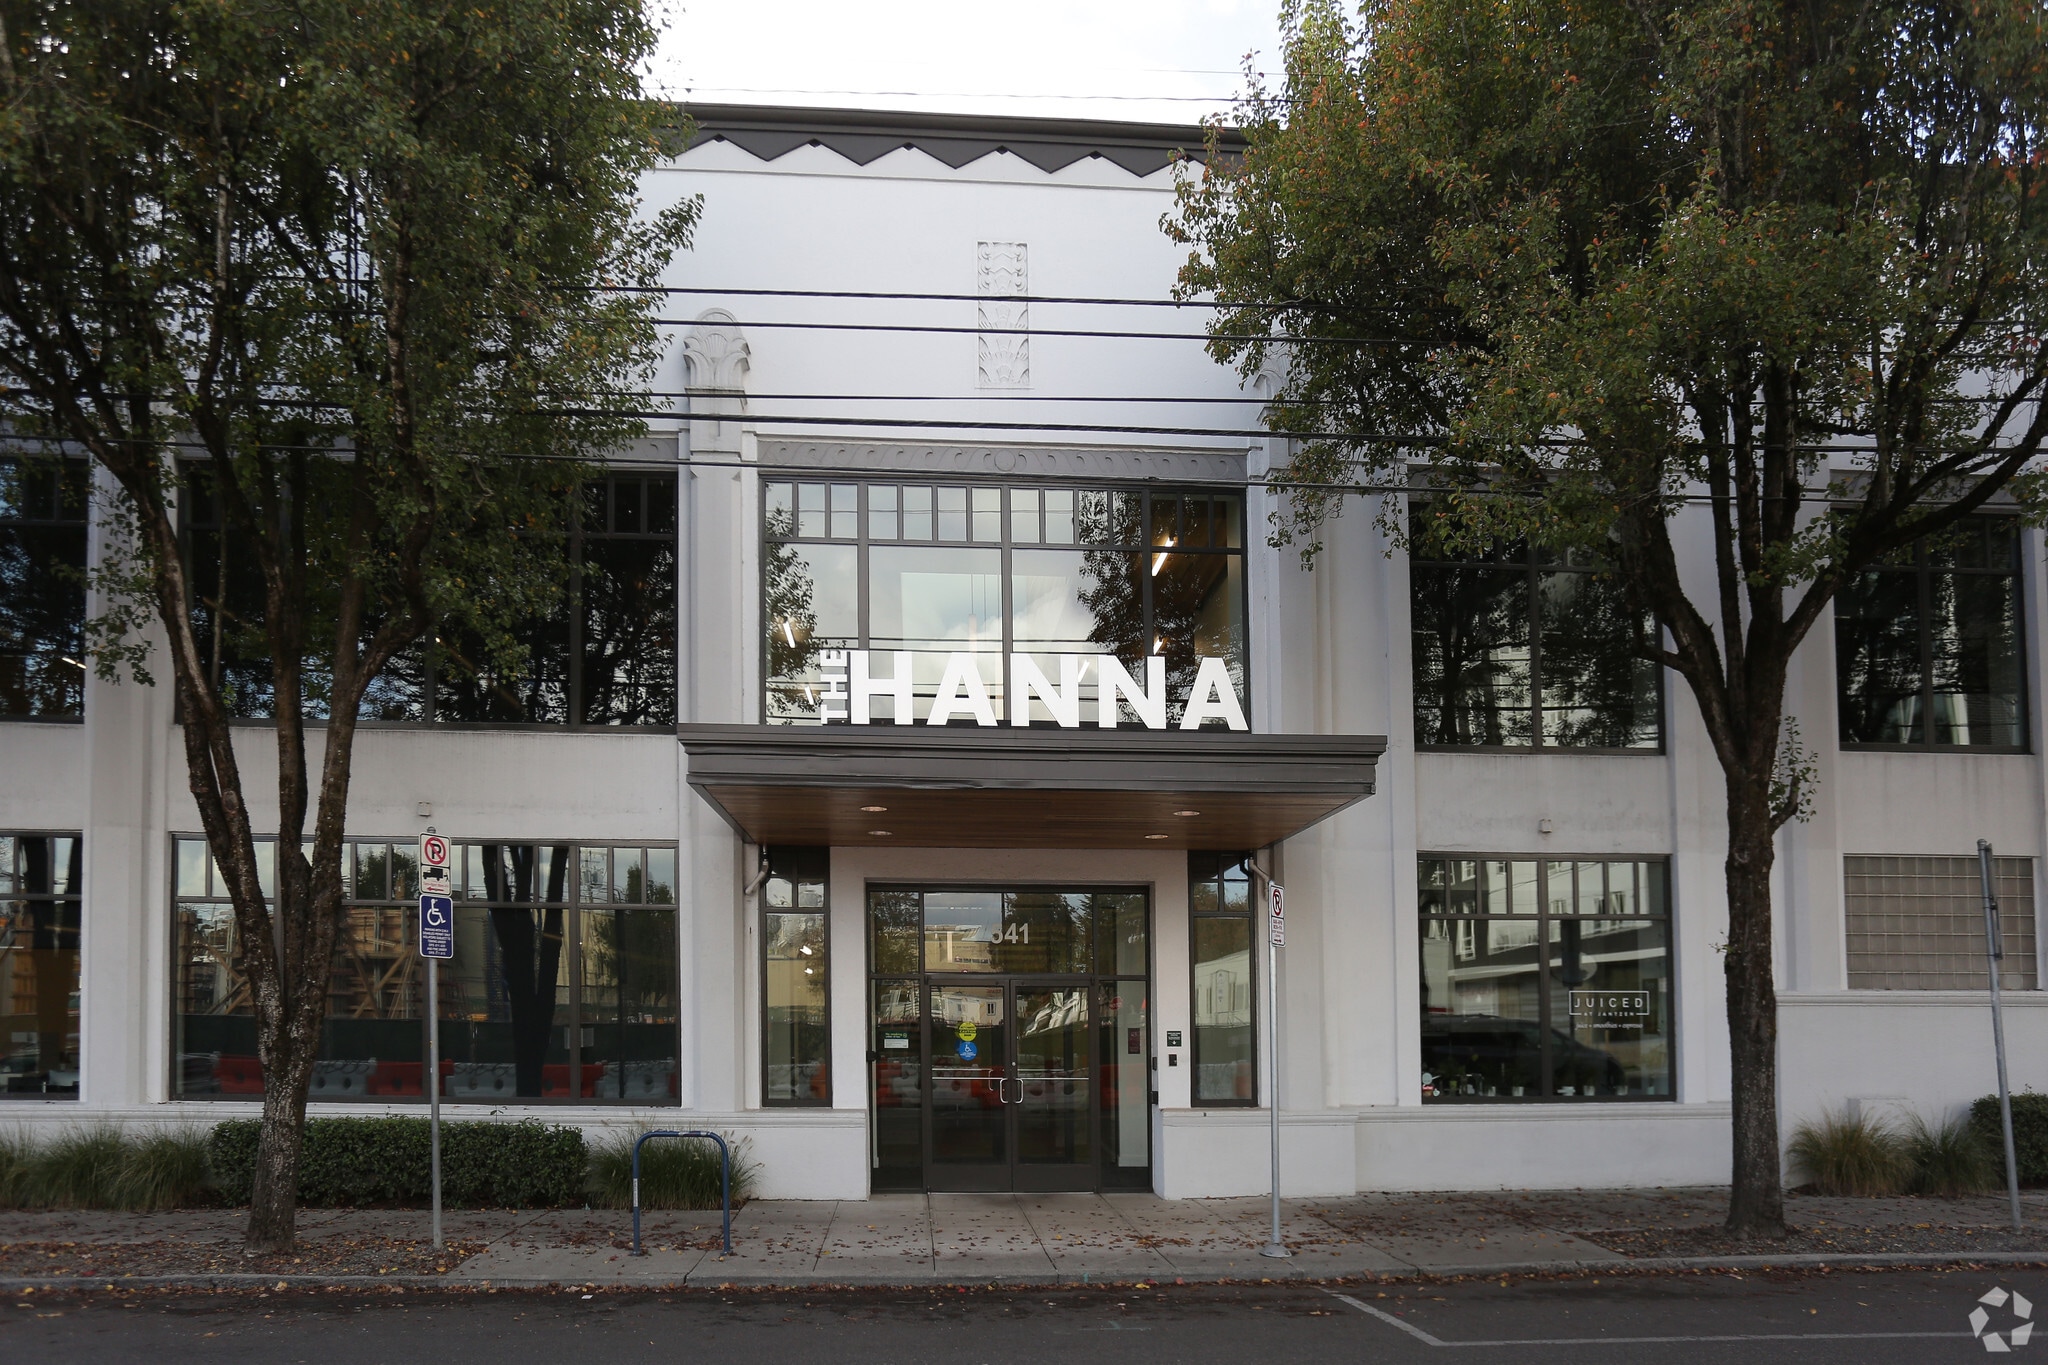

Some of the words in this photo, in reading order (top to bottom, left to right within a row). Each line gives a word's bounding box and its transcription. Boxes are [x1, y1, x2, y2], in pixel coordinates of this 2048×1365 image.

[820, 649, 849, 725] THE
[850, 651, 1249, 730] HANNA
[991, 922, 1029, 945] 541
[1574, 998, 1644, 1008] JUICED
